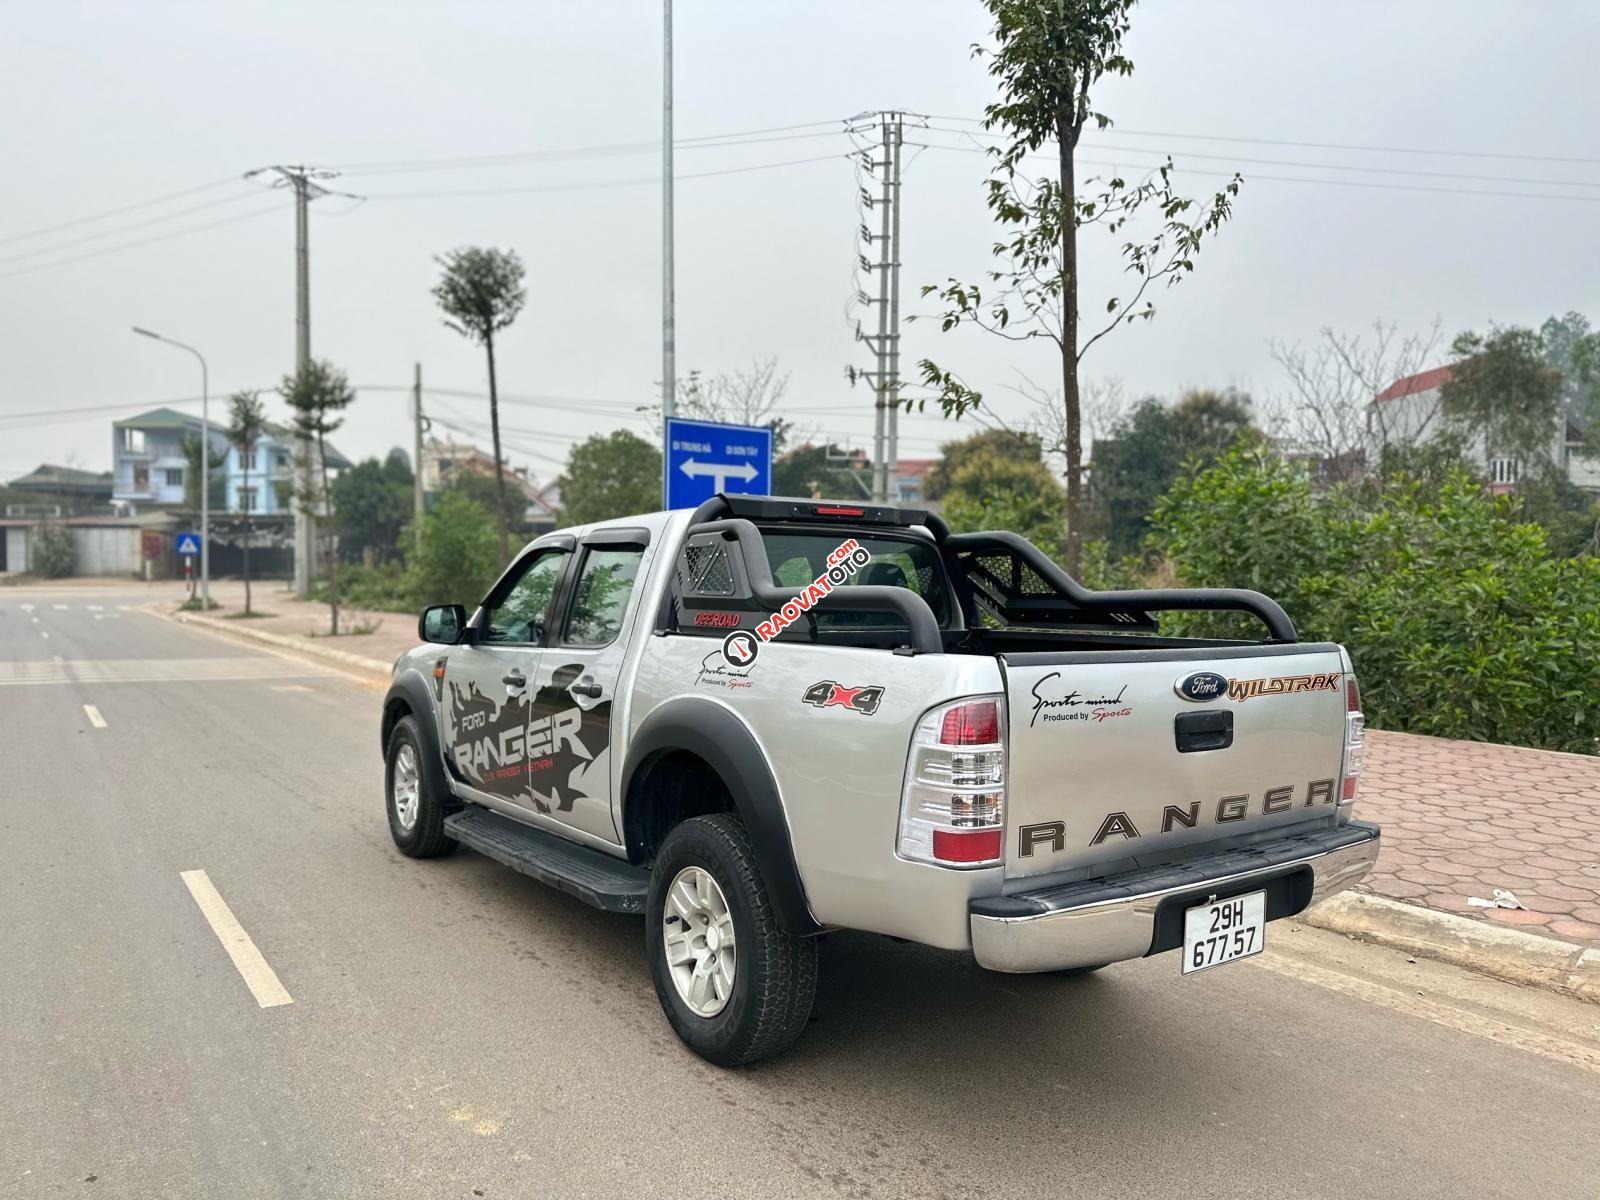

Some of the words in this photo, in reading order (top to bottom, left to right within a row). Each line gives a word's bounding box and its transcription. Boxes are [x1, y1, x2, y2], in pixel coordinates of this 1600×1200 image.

[694, 612, 742, 628] OFFROAD
[701, 678, 721, 686] Produced
[1191, 676, 1219, 695] Ford
[1226, 672, 1342, 702] WILDTRAK
[462, 711, 486, 732] FORD
[1043, 713, 1079, 722] Produced
[1079, 712, 1089, 721] by
[1092, 707, 1133, 723] Sports
[455, 707, 594, 784] RANGER
[1018, 778, 1336, 859] RANGER
[1209, 900, 1244, 934] 29H
[1193, 926, 1256, 968] 677.57
